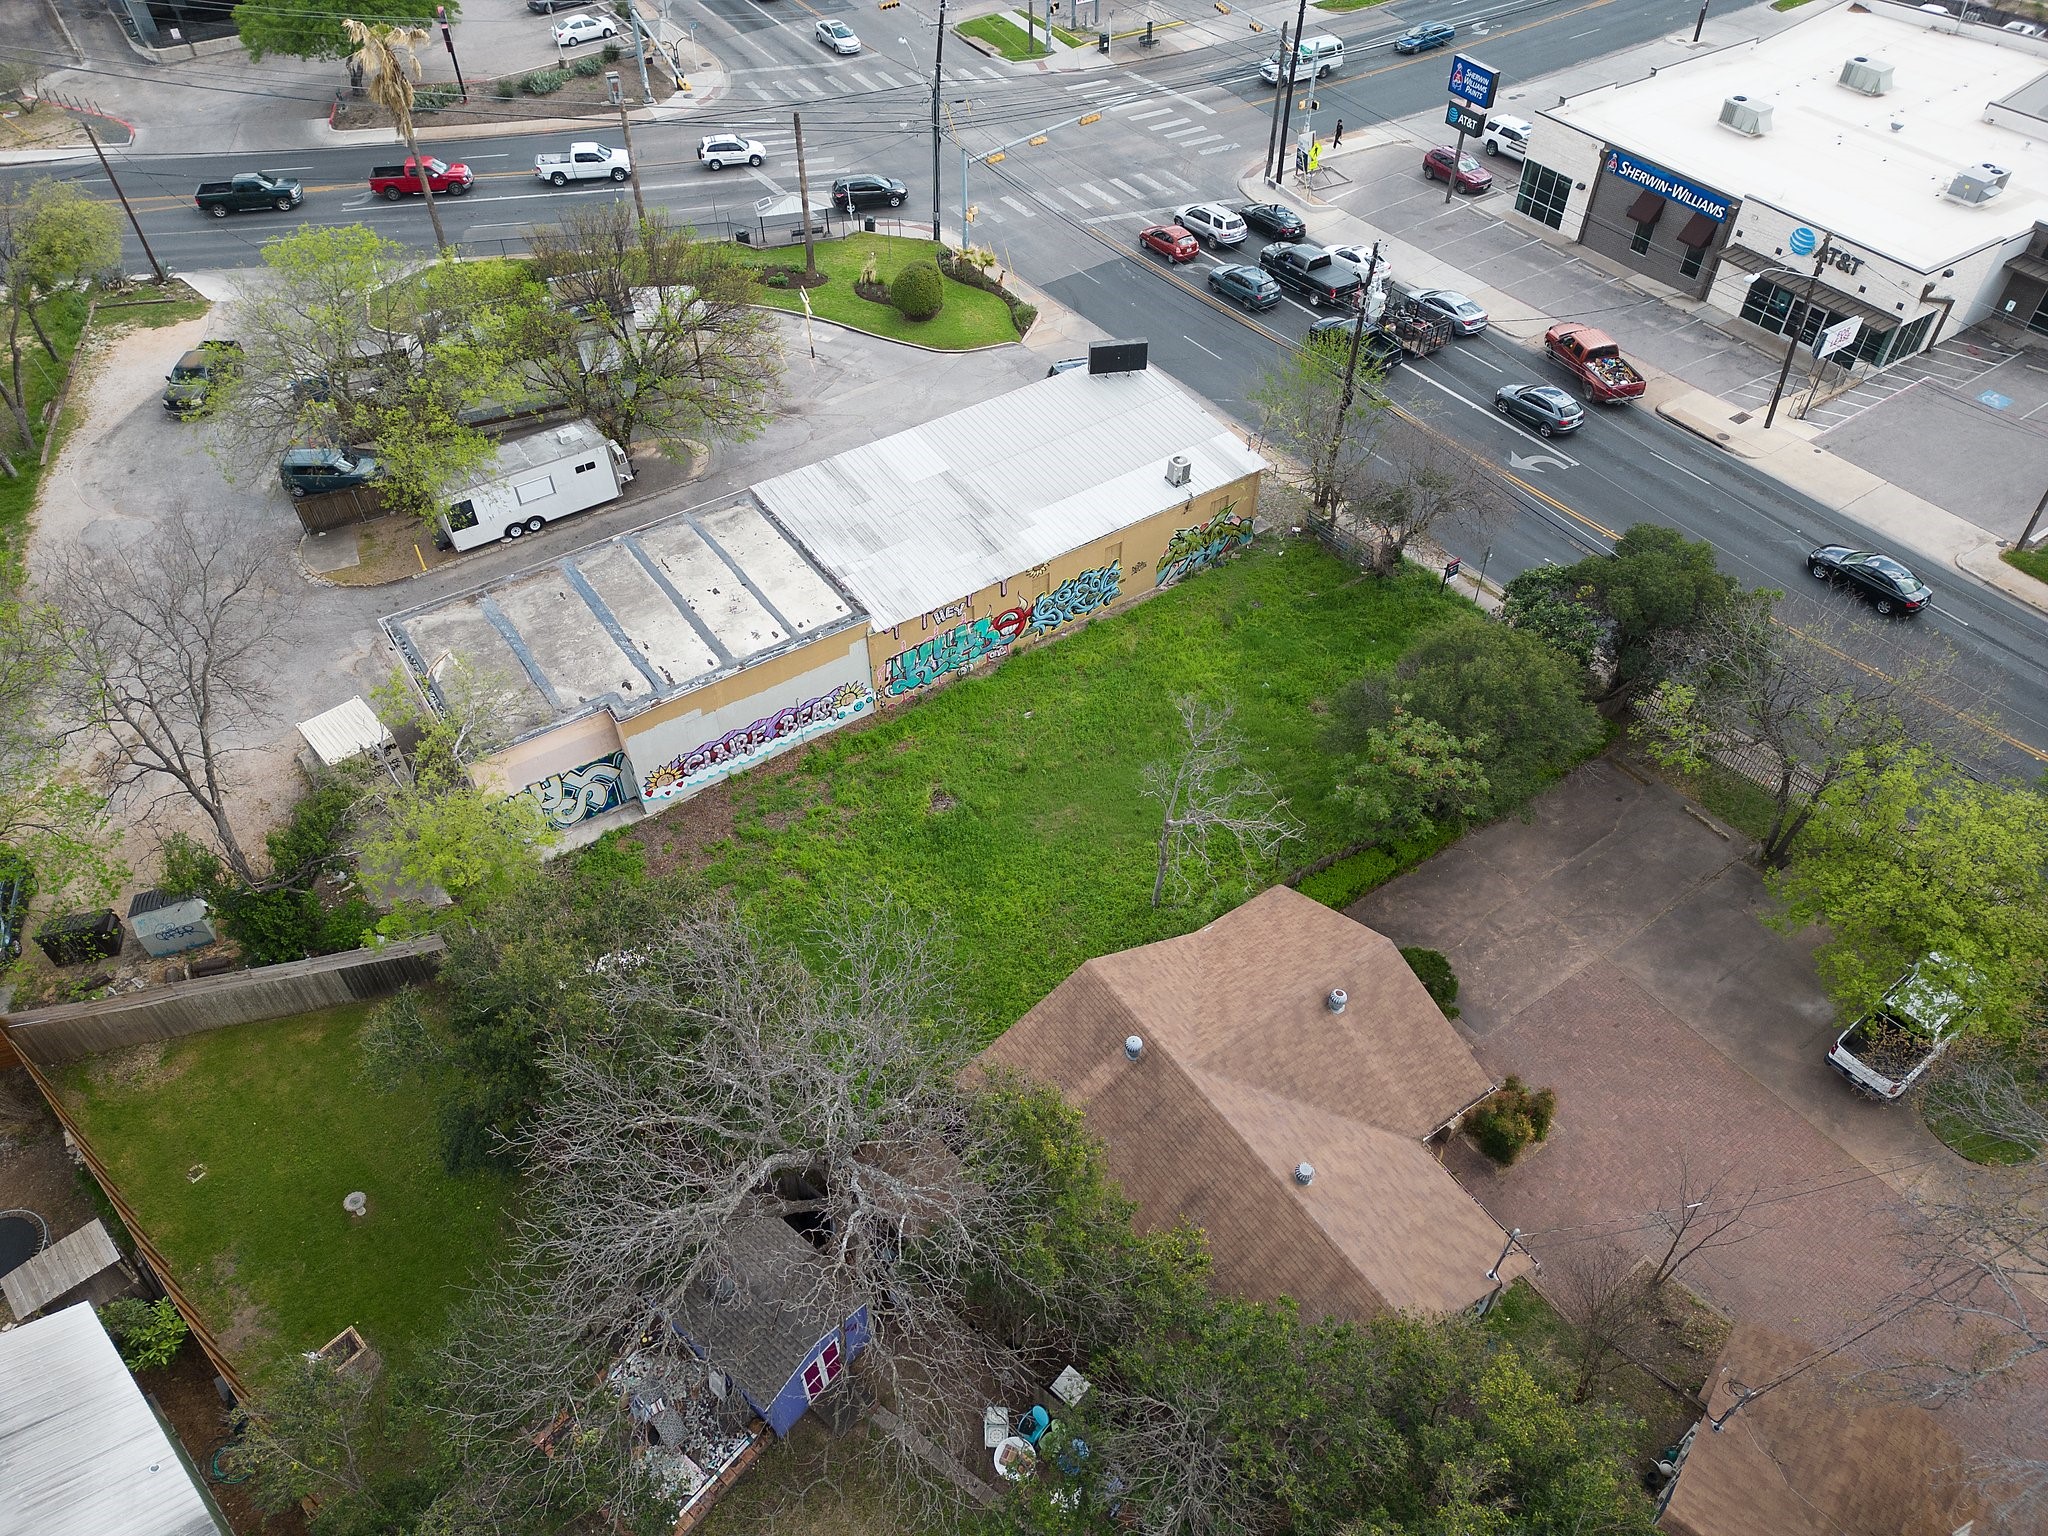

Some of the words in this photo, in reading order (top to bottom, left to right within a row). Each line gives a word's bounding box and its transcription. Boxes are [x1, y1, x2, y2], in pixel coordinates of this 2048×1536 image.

[1463, 76, 1488, 94] WILLIAMS
[1465, 68, 1490, 86] SHERWIN
[1464, 86, 1483, 99] PAINTS
[1457, 114, 1478, 130] AT&T
[932, 602, 965, 625] HEY
[778, 695, 840, 736] BEAR
[682, 725, 772, 776] CLAIRE
